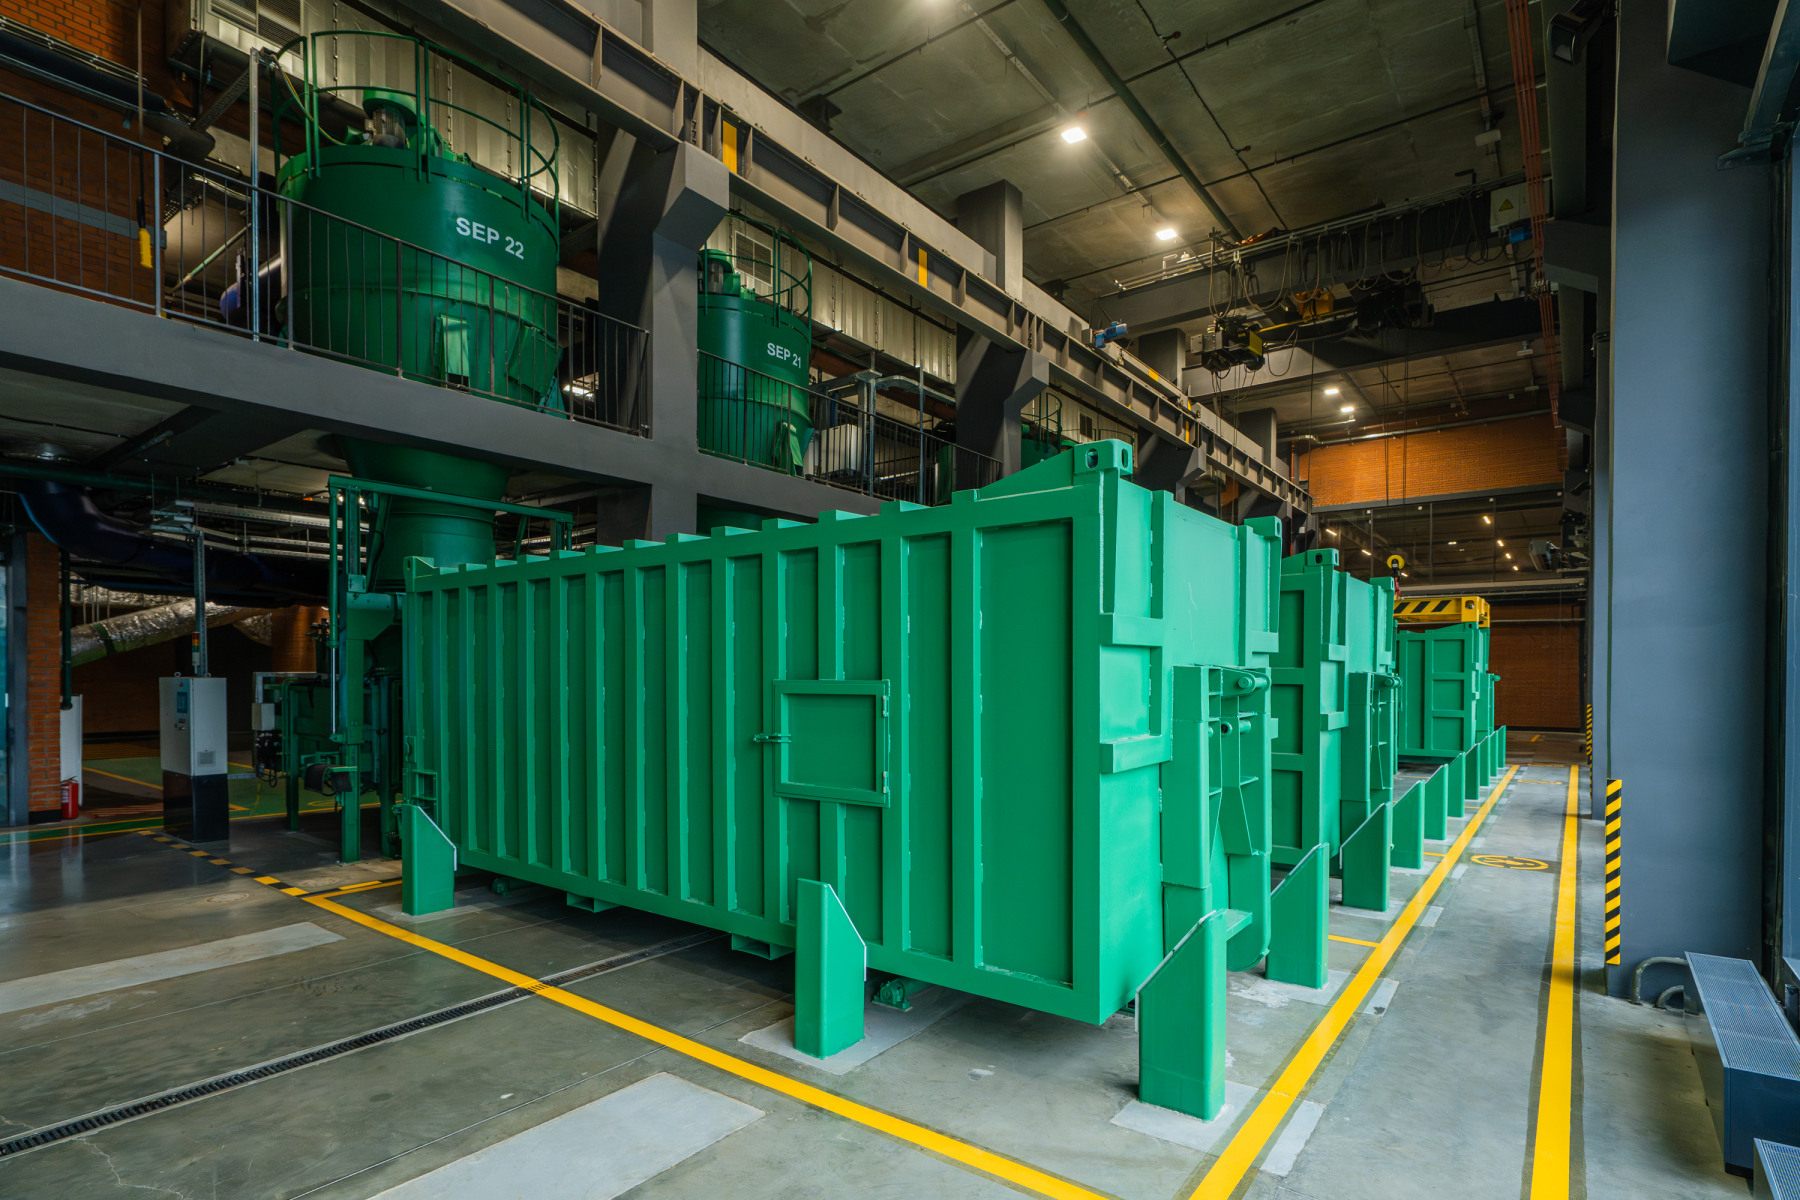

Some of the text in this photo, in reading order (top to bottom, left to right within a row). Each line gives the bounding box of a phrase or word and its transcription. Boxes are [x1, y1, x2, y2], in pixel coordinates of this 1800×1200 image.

[456, 217, 524, 260] SEP 22
[767, 342, 802, 368] SEP 21
